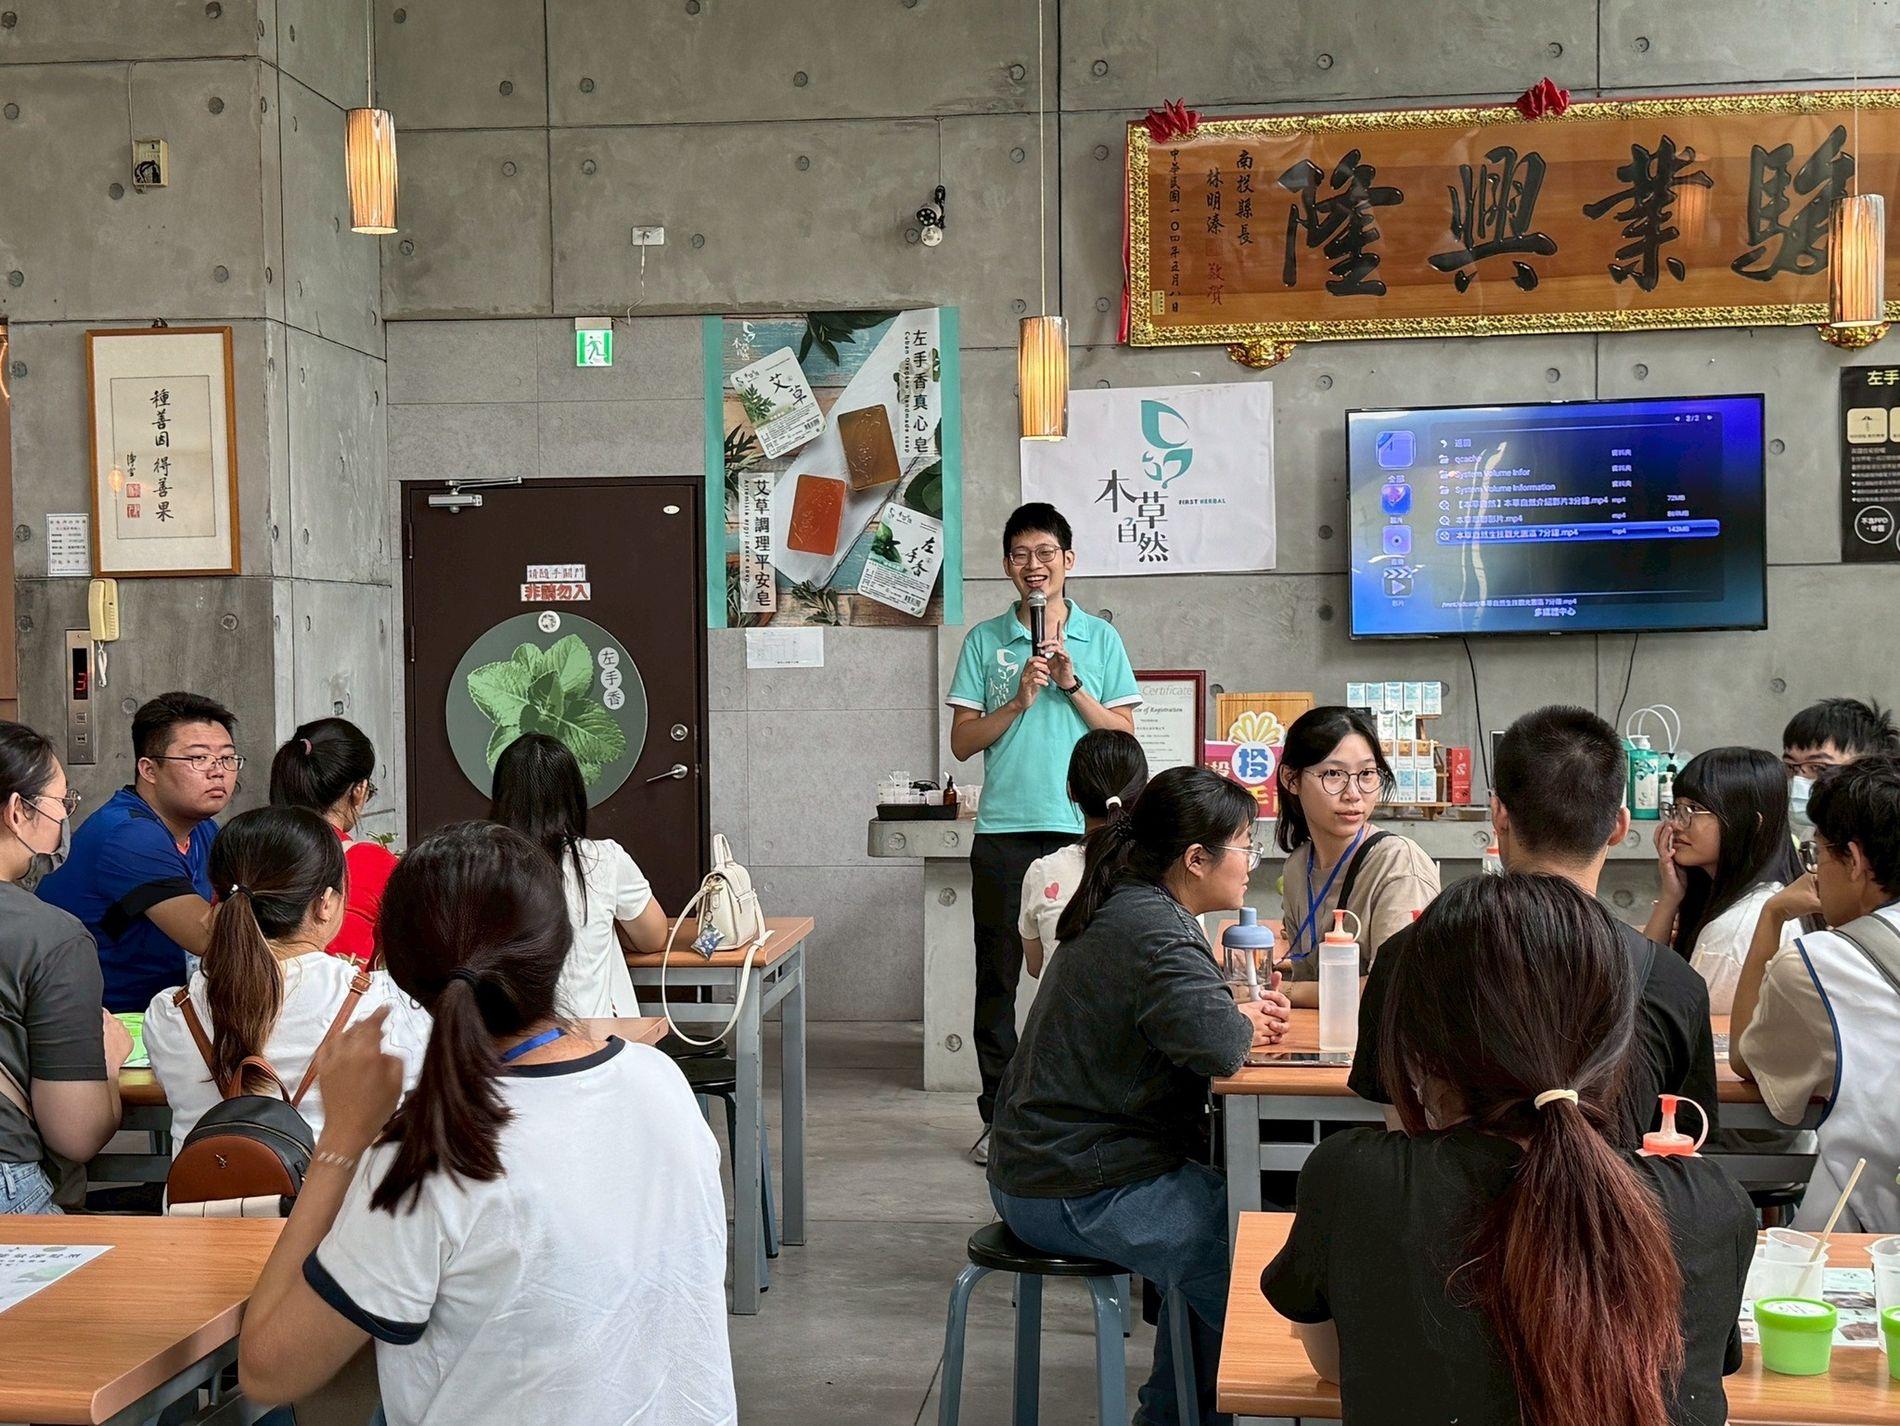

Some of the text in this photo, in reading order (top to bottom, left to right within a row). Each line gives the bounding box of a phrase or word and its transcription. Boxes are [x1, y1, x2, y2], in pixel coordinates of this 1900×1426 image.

[1867, 369, 1900, 386] 左手
[913, 329, 929, 453] 左手香真心皂
[1513, 483, 1556, 492] Information
[754, 479, 771, 607] 艾草調理平安皂
[1142, 684, 1193, 697] Certificate
